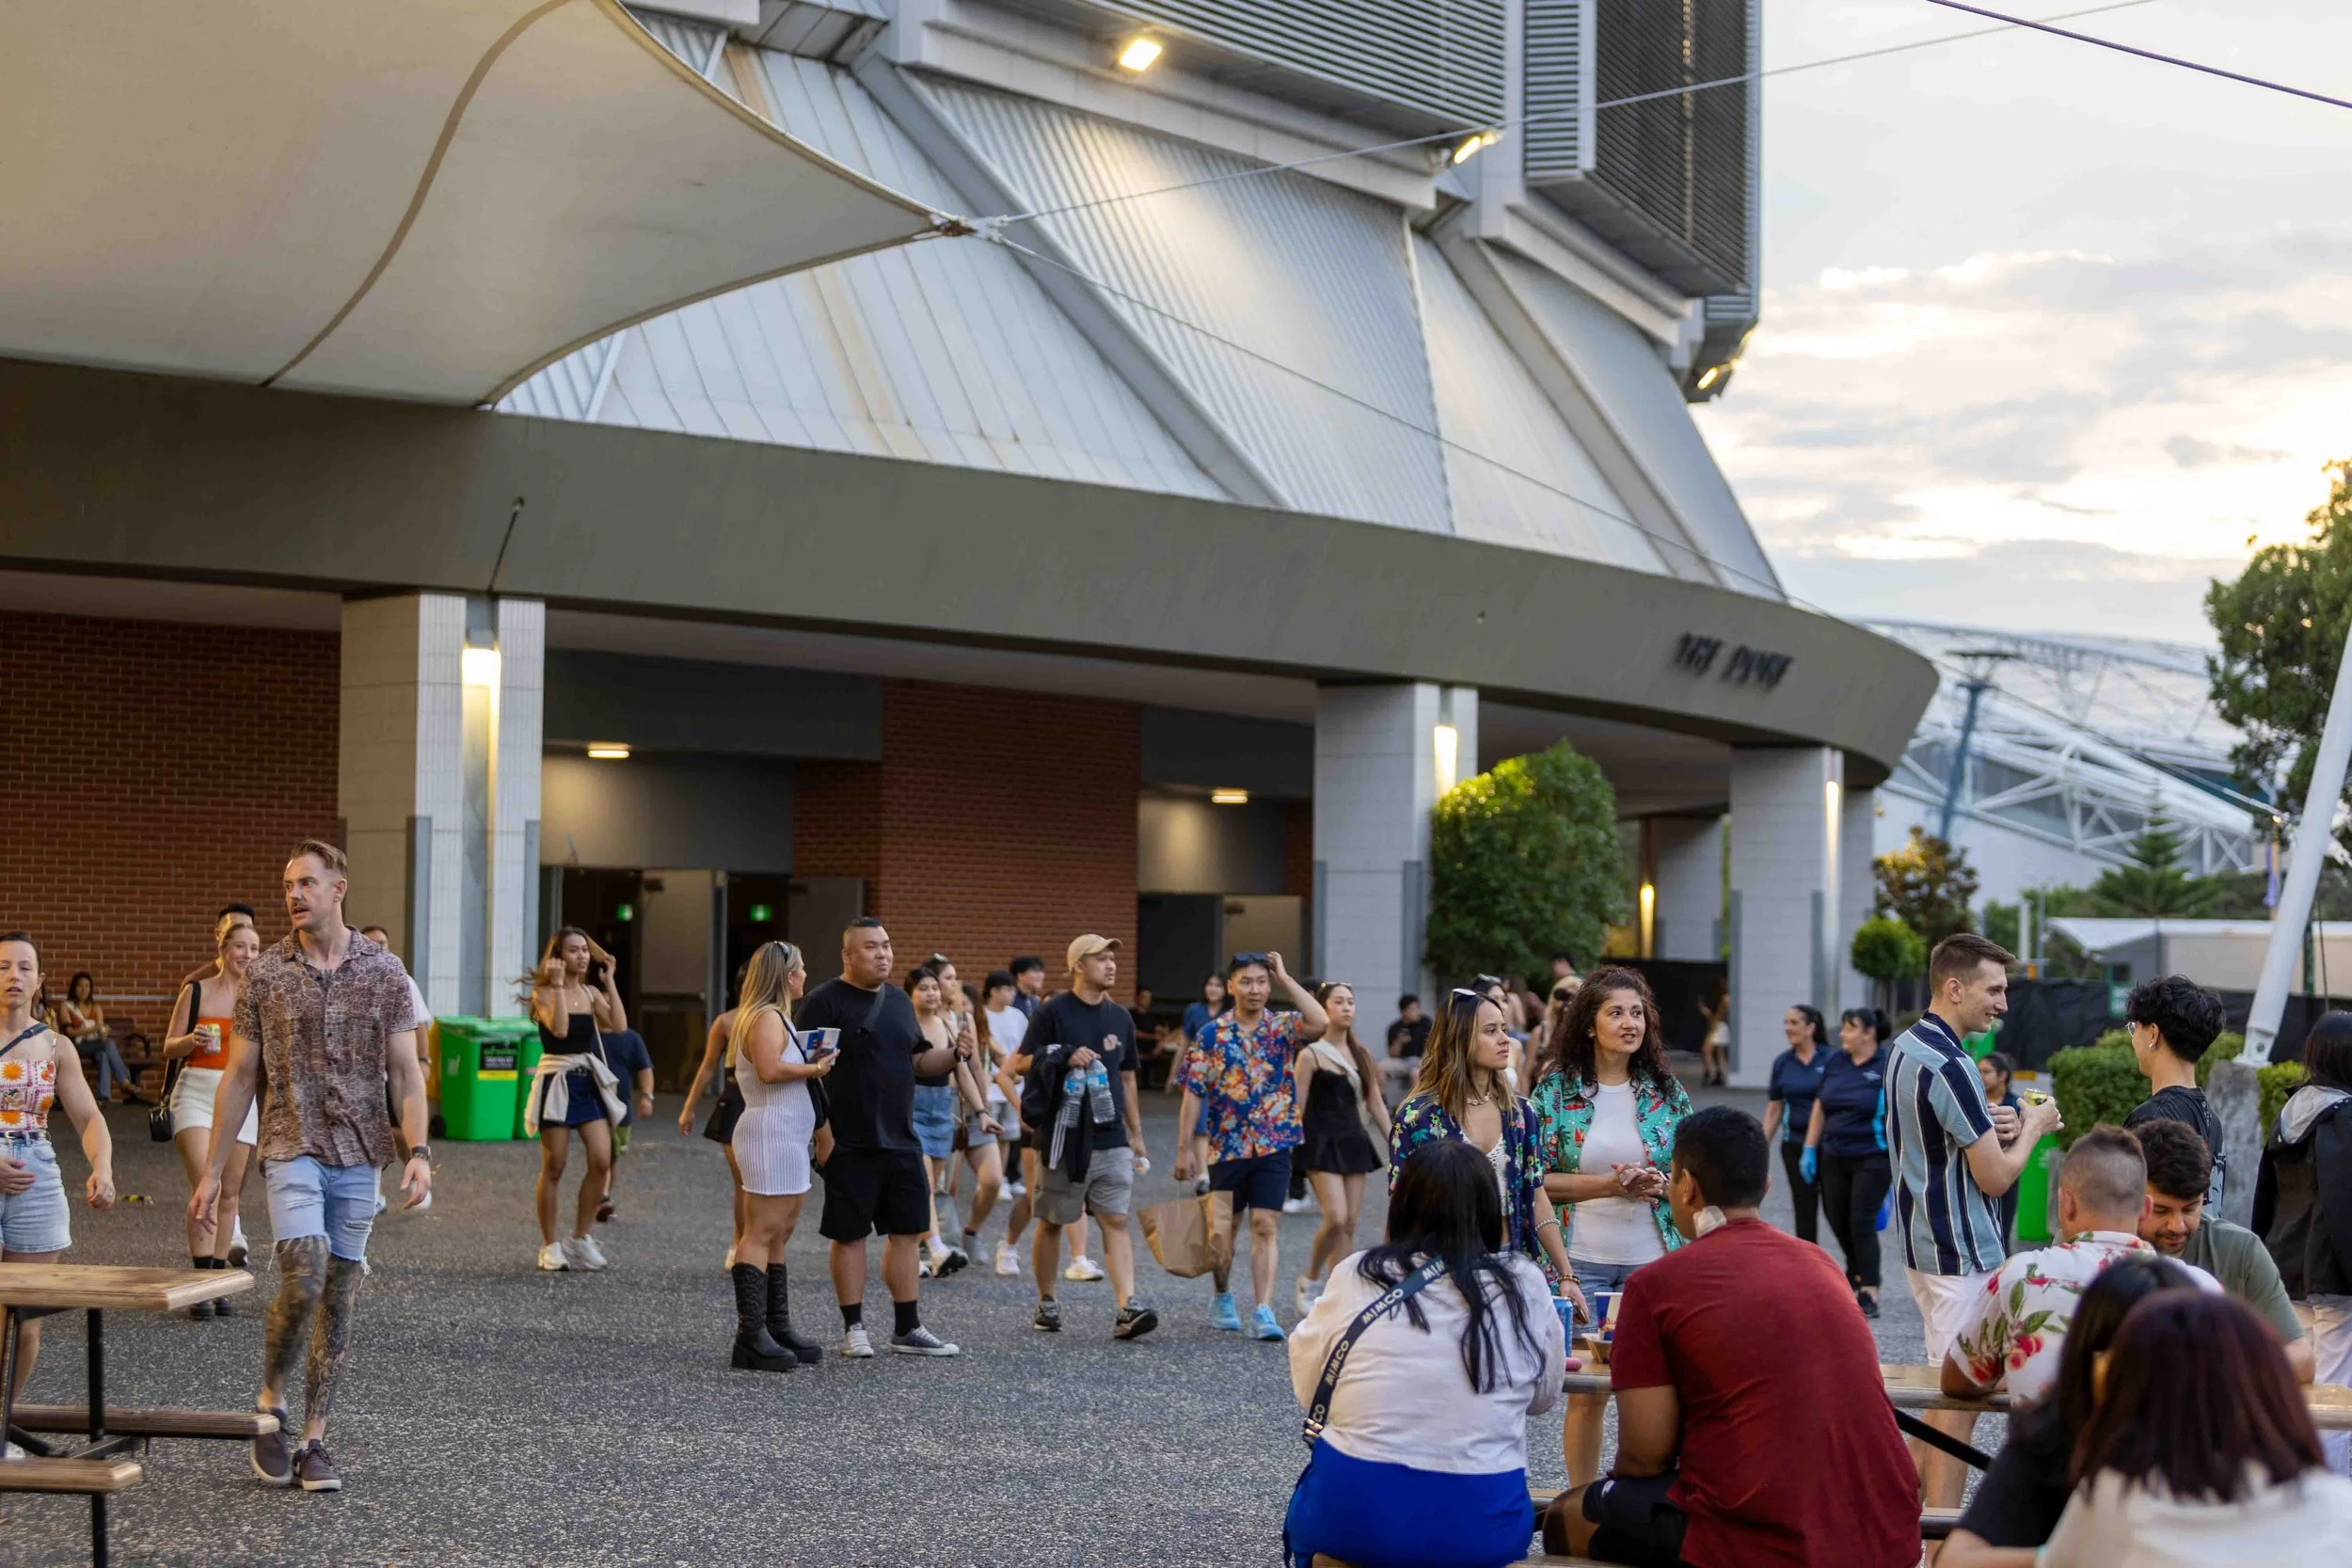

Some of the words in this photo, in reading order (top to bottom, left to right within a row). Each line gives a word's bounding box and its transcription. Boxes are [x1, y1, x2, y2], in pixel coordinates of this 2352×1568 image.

[1422, 1259, 1445, 1280] MIM
[1362, 1288, 1404, 1324] MIMCO
[1325, 1339, 1349, 1386] MIMCO
